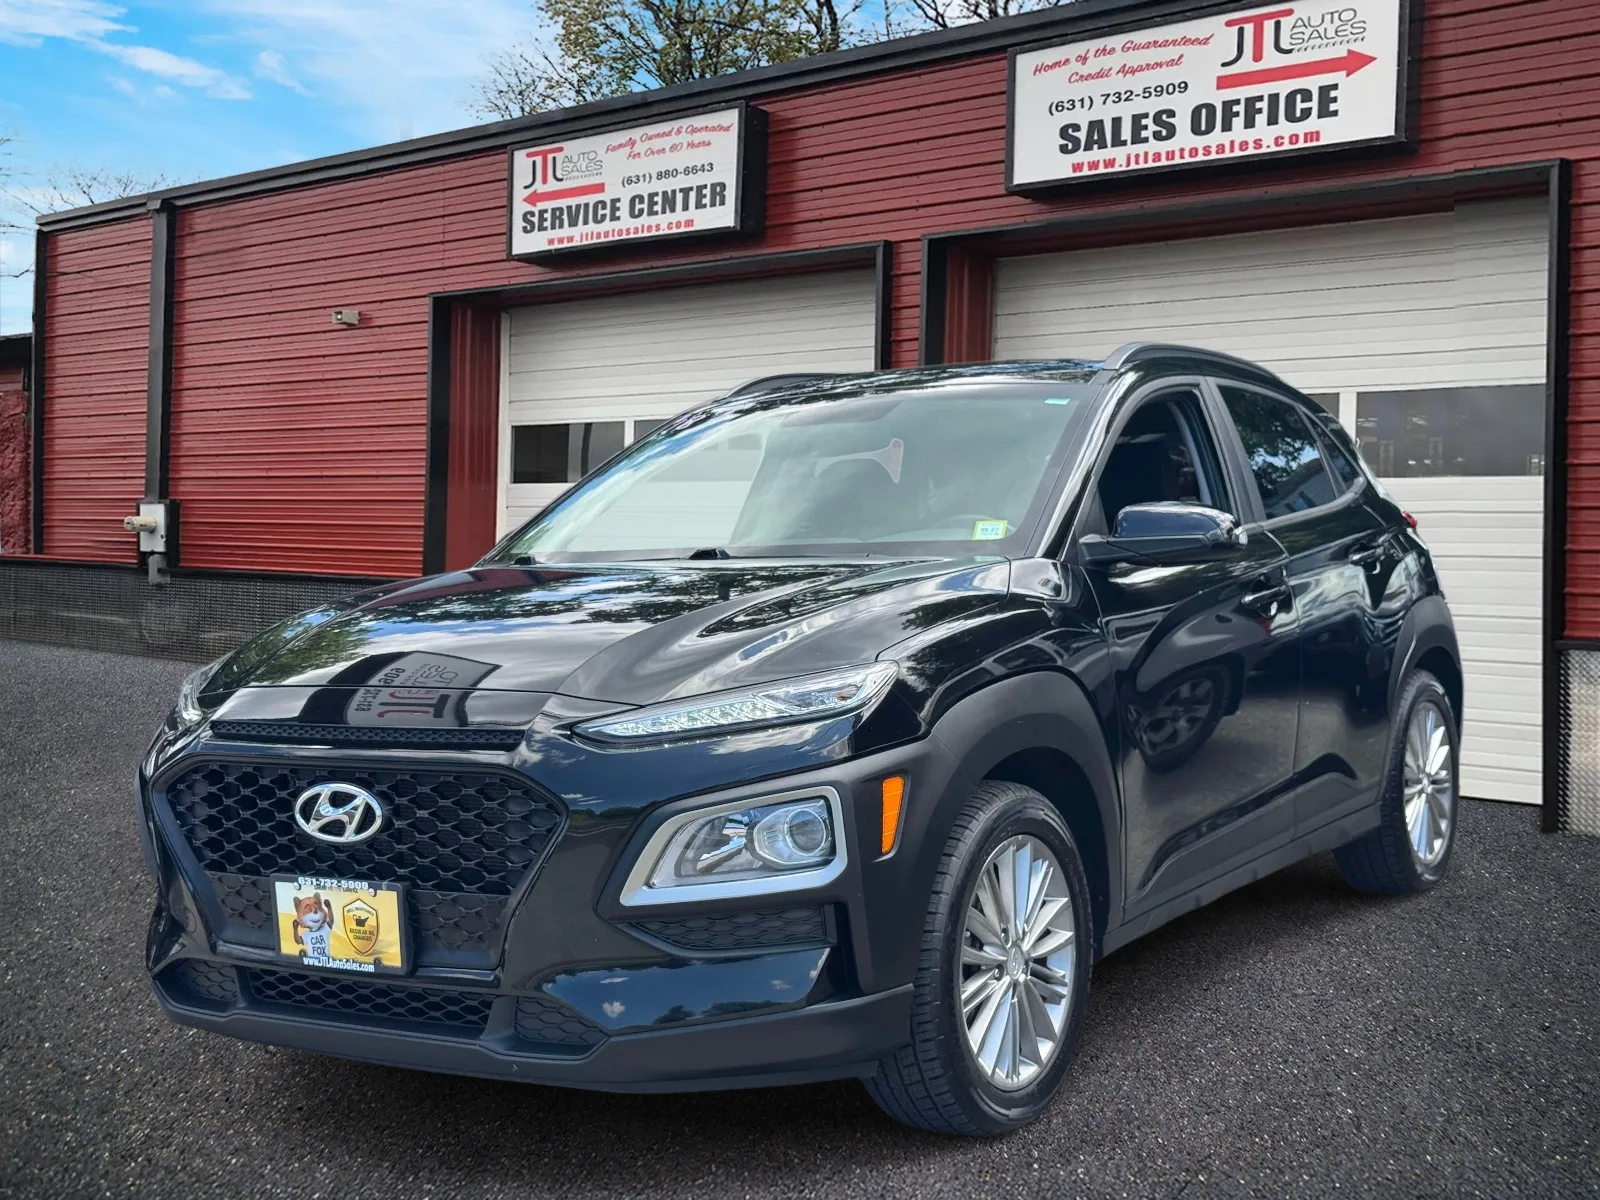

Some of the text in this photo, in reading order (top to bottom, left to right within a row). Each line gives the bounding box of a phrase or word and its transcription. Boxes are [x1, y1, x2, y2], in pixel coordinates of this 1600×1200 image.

[1289, 20, 1367, 46] SALES
[1290, 7, 1357, 32] AUTO
[1220, 8, 1295, 68] JTL
[1033, 33, 1215, 76] Home of the Guaranteed
[1068, 54, 1184, 84] Credit Approval
[1048, 81, 1189, 116] (631) 732-5909
[1058, 82, 1339, 155] SALES OFFICE
[605, 123, 734, 154] Family Owned & Operated
[627, 140, 712, 160] For Over 60 Years
[1071, 129, 1321, 174] www.jtlautosales.com
[523, 146, 564, 189] JTL
[561, 159, 603, 176] SALES
[562, 150, 598, 166] AUTO
[621, 172, 652, 188] (631)
[656, 162, 714, 181] 880-6643
[521, 181, 727, 234] SERVICE CENTER
[547, 218, 695, 246] www.jtlautosales.com
[298, 877, 369, 890] 631-732-5909
[310, 935, 326, 945] CAR
[312, 946, 327, 957] FOX
[303, 956, 375, 973] www.JTLAutoSales.com
